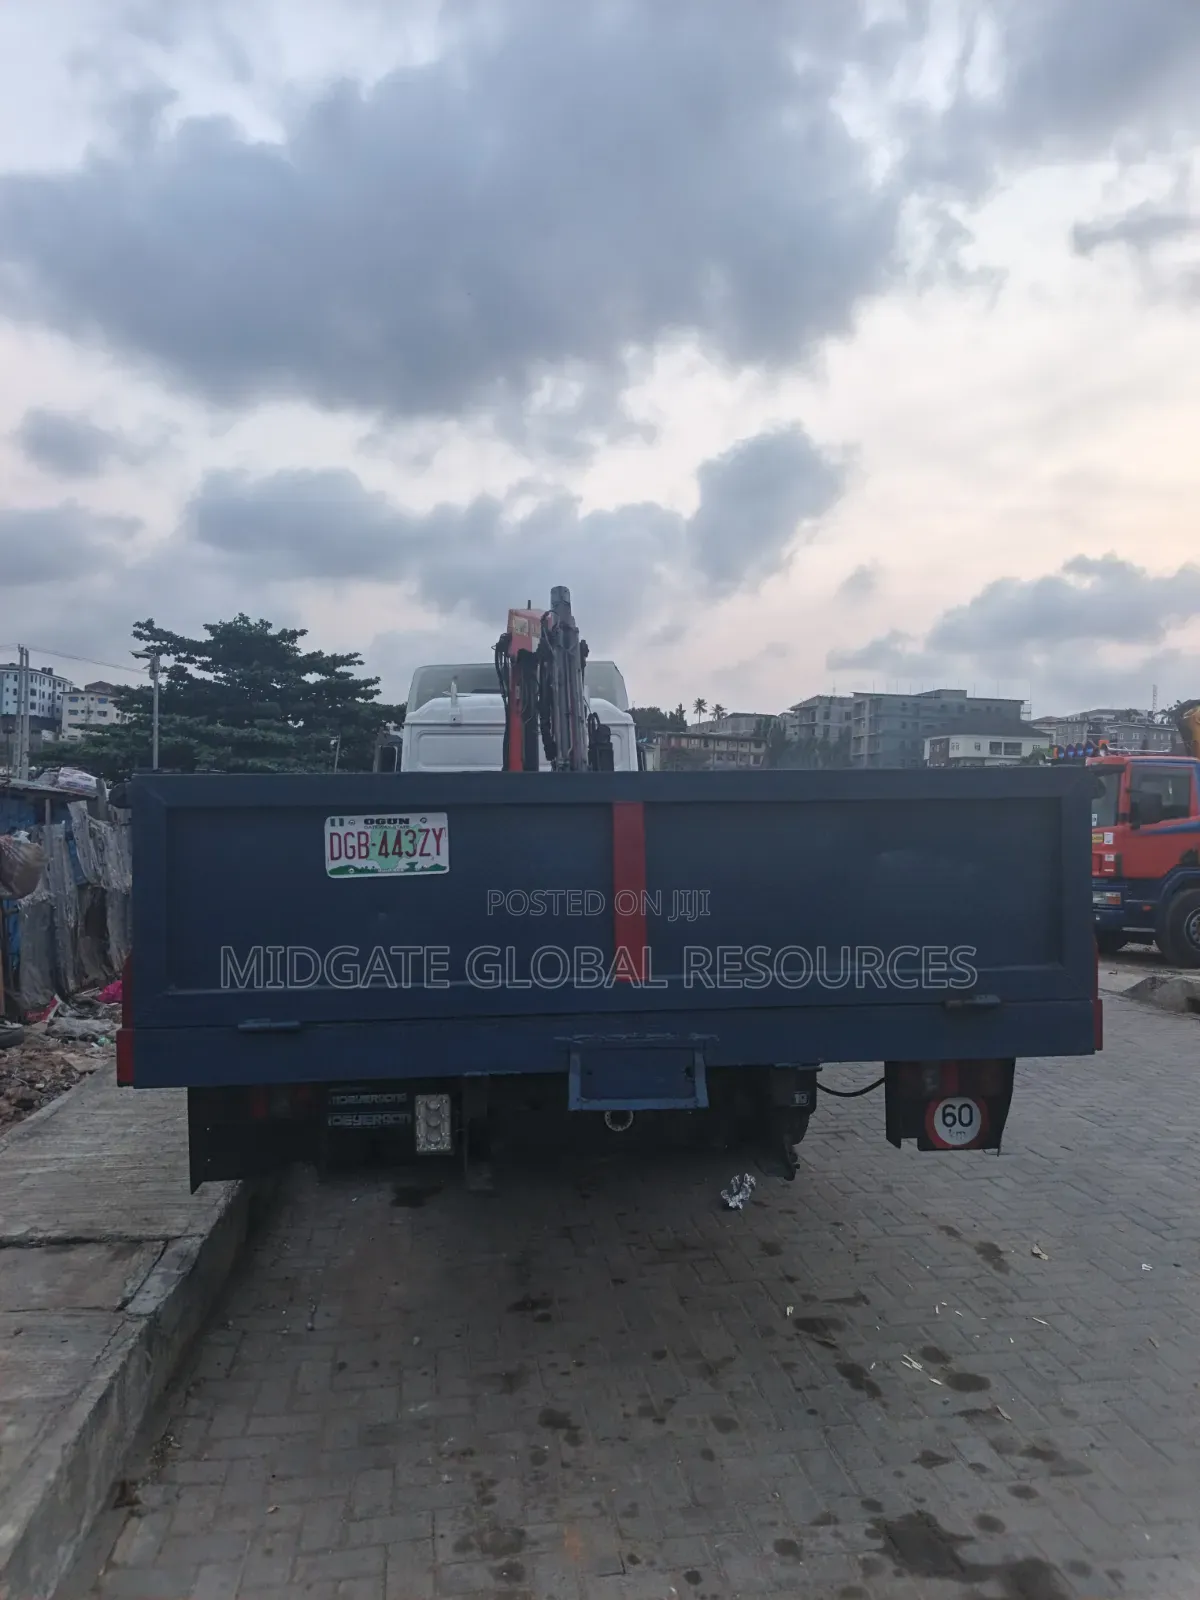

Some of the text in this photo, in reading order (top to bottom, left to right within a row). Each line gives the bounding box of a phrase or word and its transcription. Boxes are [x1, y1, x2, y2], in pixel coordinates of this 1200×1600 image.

[364, 817, 410, 825] OGUN
[329, 828, 446, 861] DGB-443ZY
[942, 1103, 974, 1127] 60
